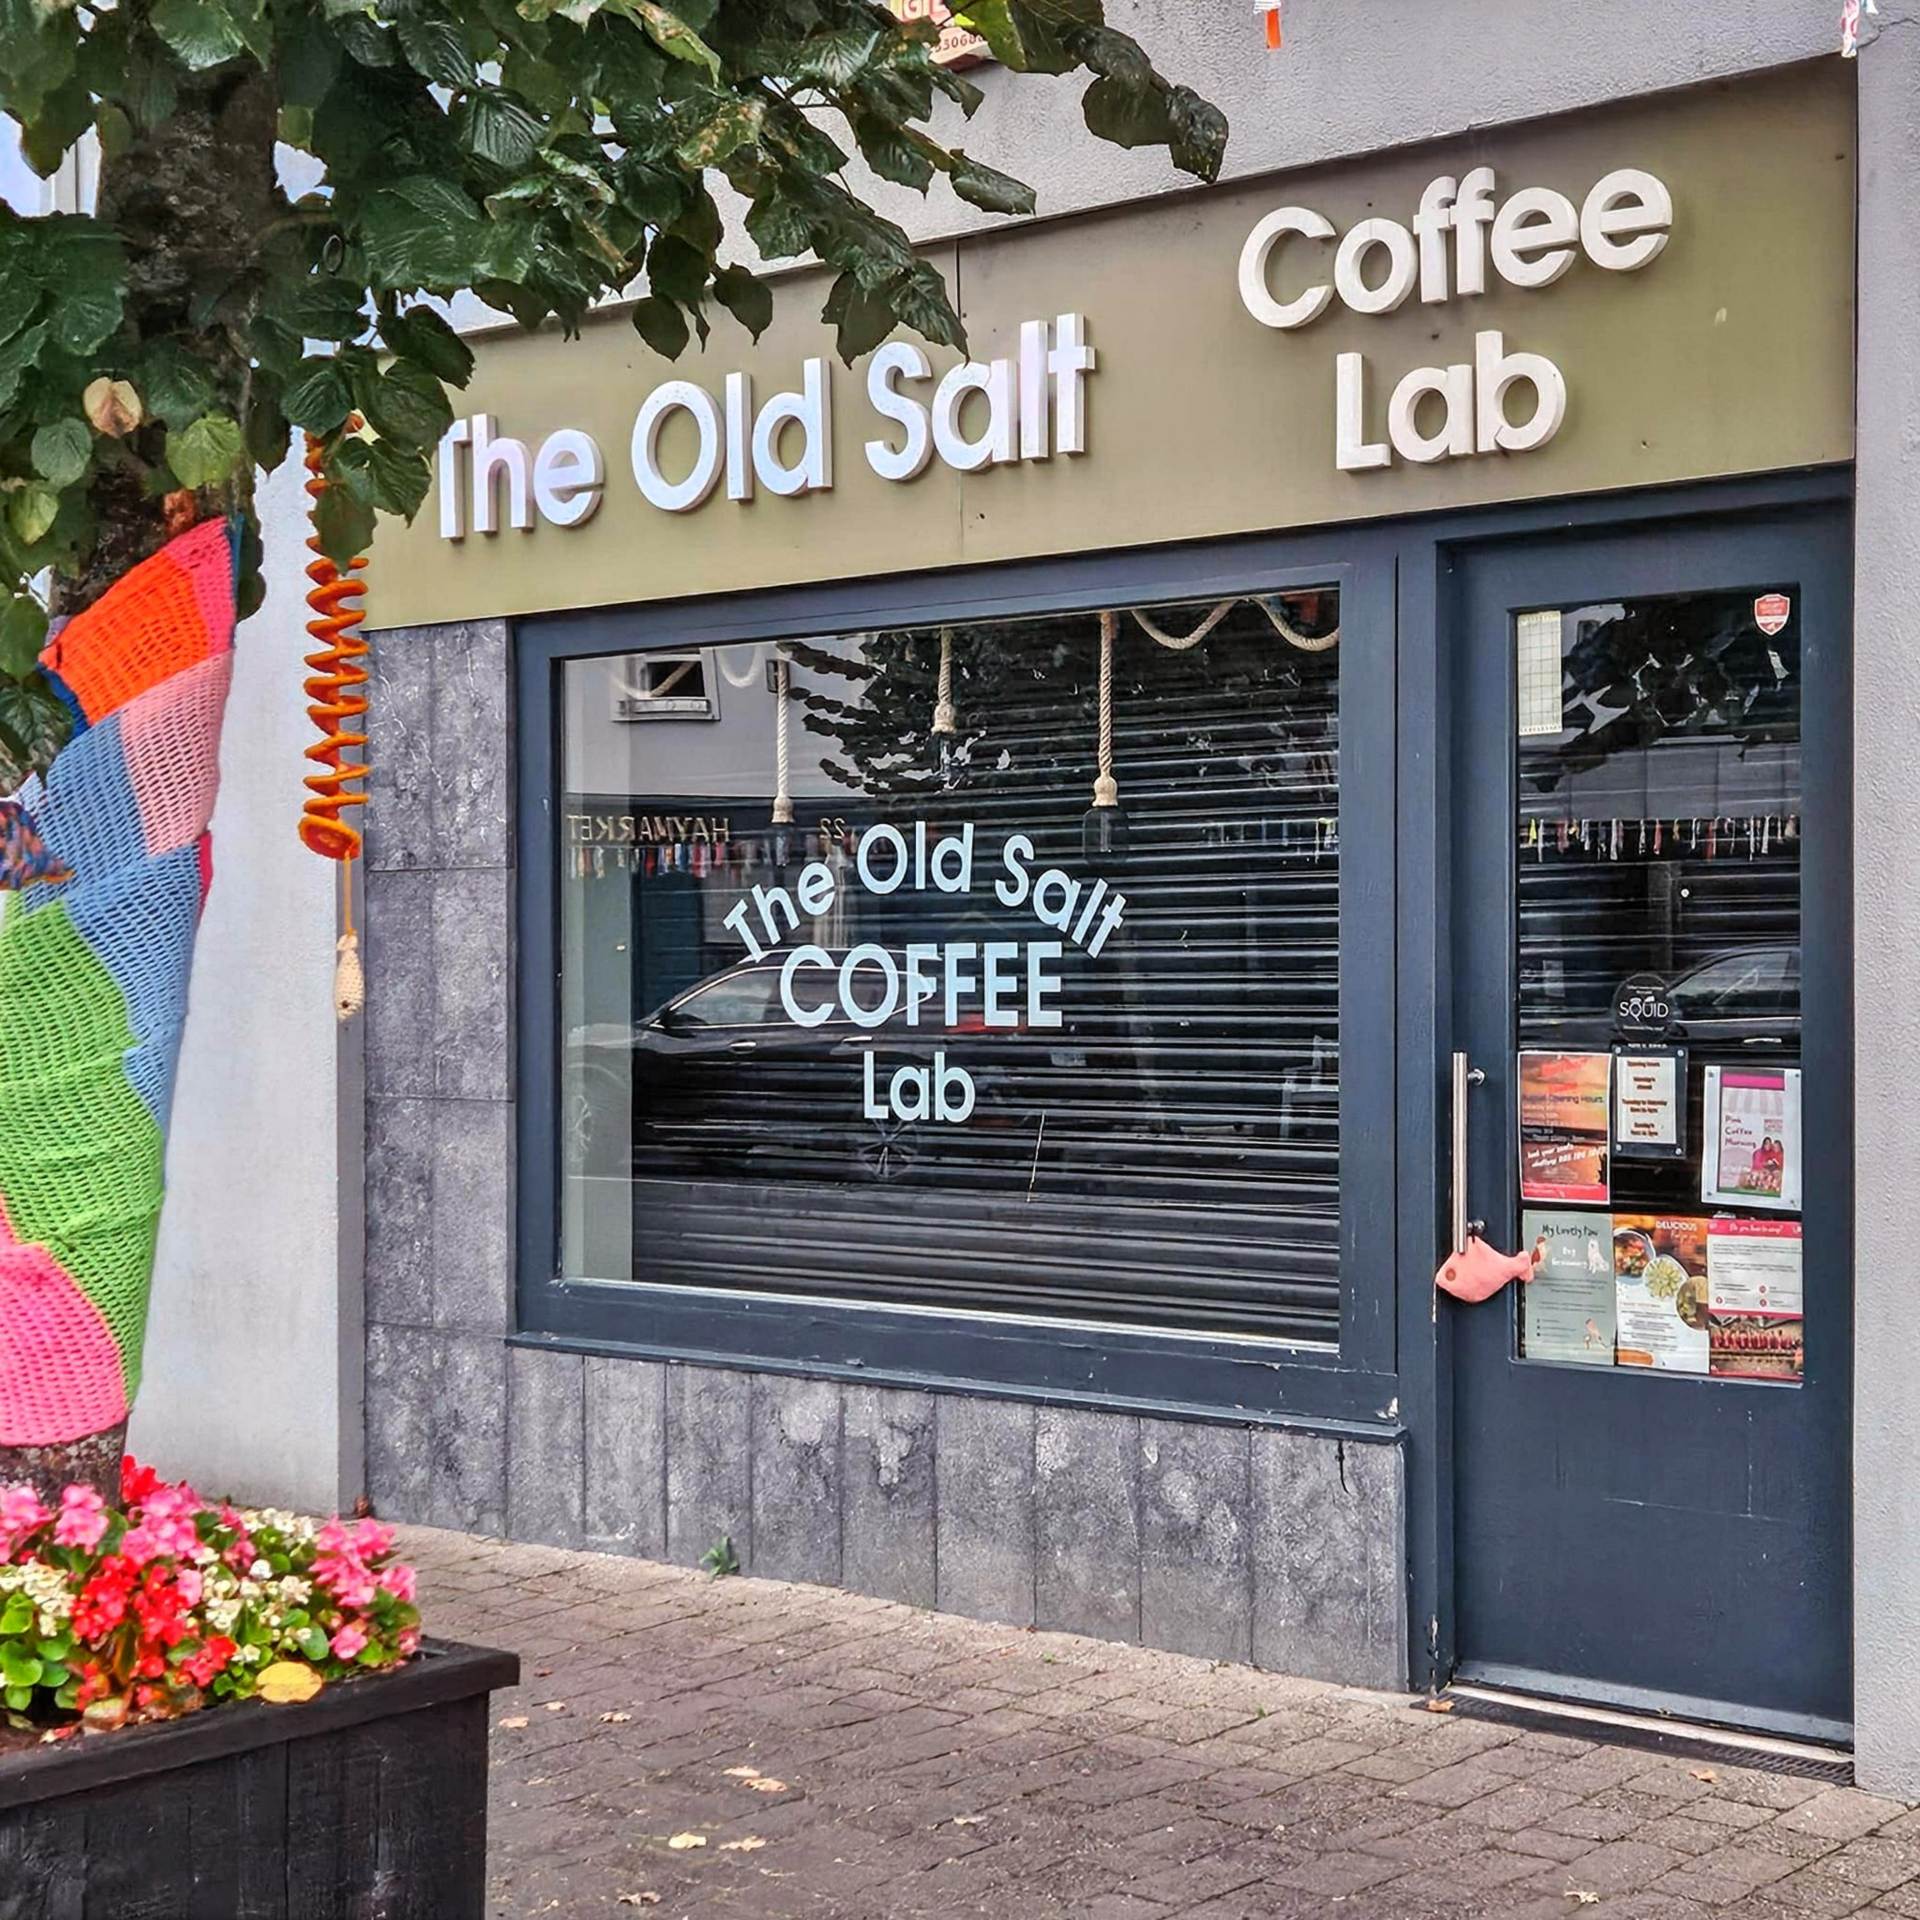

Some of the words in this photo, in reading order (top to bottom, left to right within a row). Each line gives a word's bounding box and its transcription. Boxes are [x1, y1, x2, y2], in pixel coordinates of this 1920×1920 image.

[1238, 167, 1672, 329] Coffee
[438, 413, 604, 540] The
[631, 357, 833, 512] Old
[865, 313, 1096, 480] Salt
[1336, 330, 1566, 471] Lab
[722, 862, 836, 963] The
[857, 821, 974, 894] Old
[995, 834, 1127, 959] Salt
[780, 941, 1063, 1028] COFFEE
[1619, 997, 1669, 1022] SQUID
[864, 1051, 976, 1123] Lab
